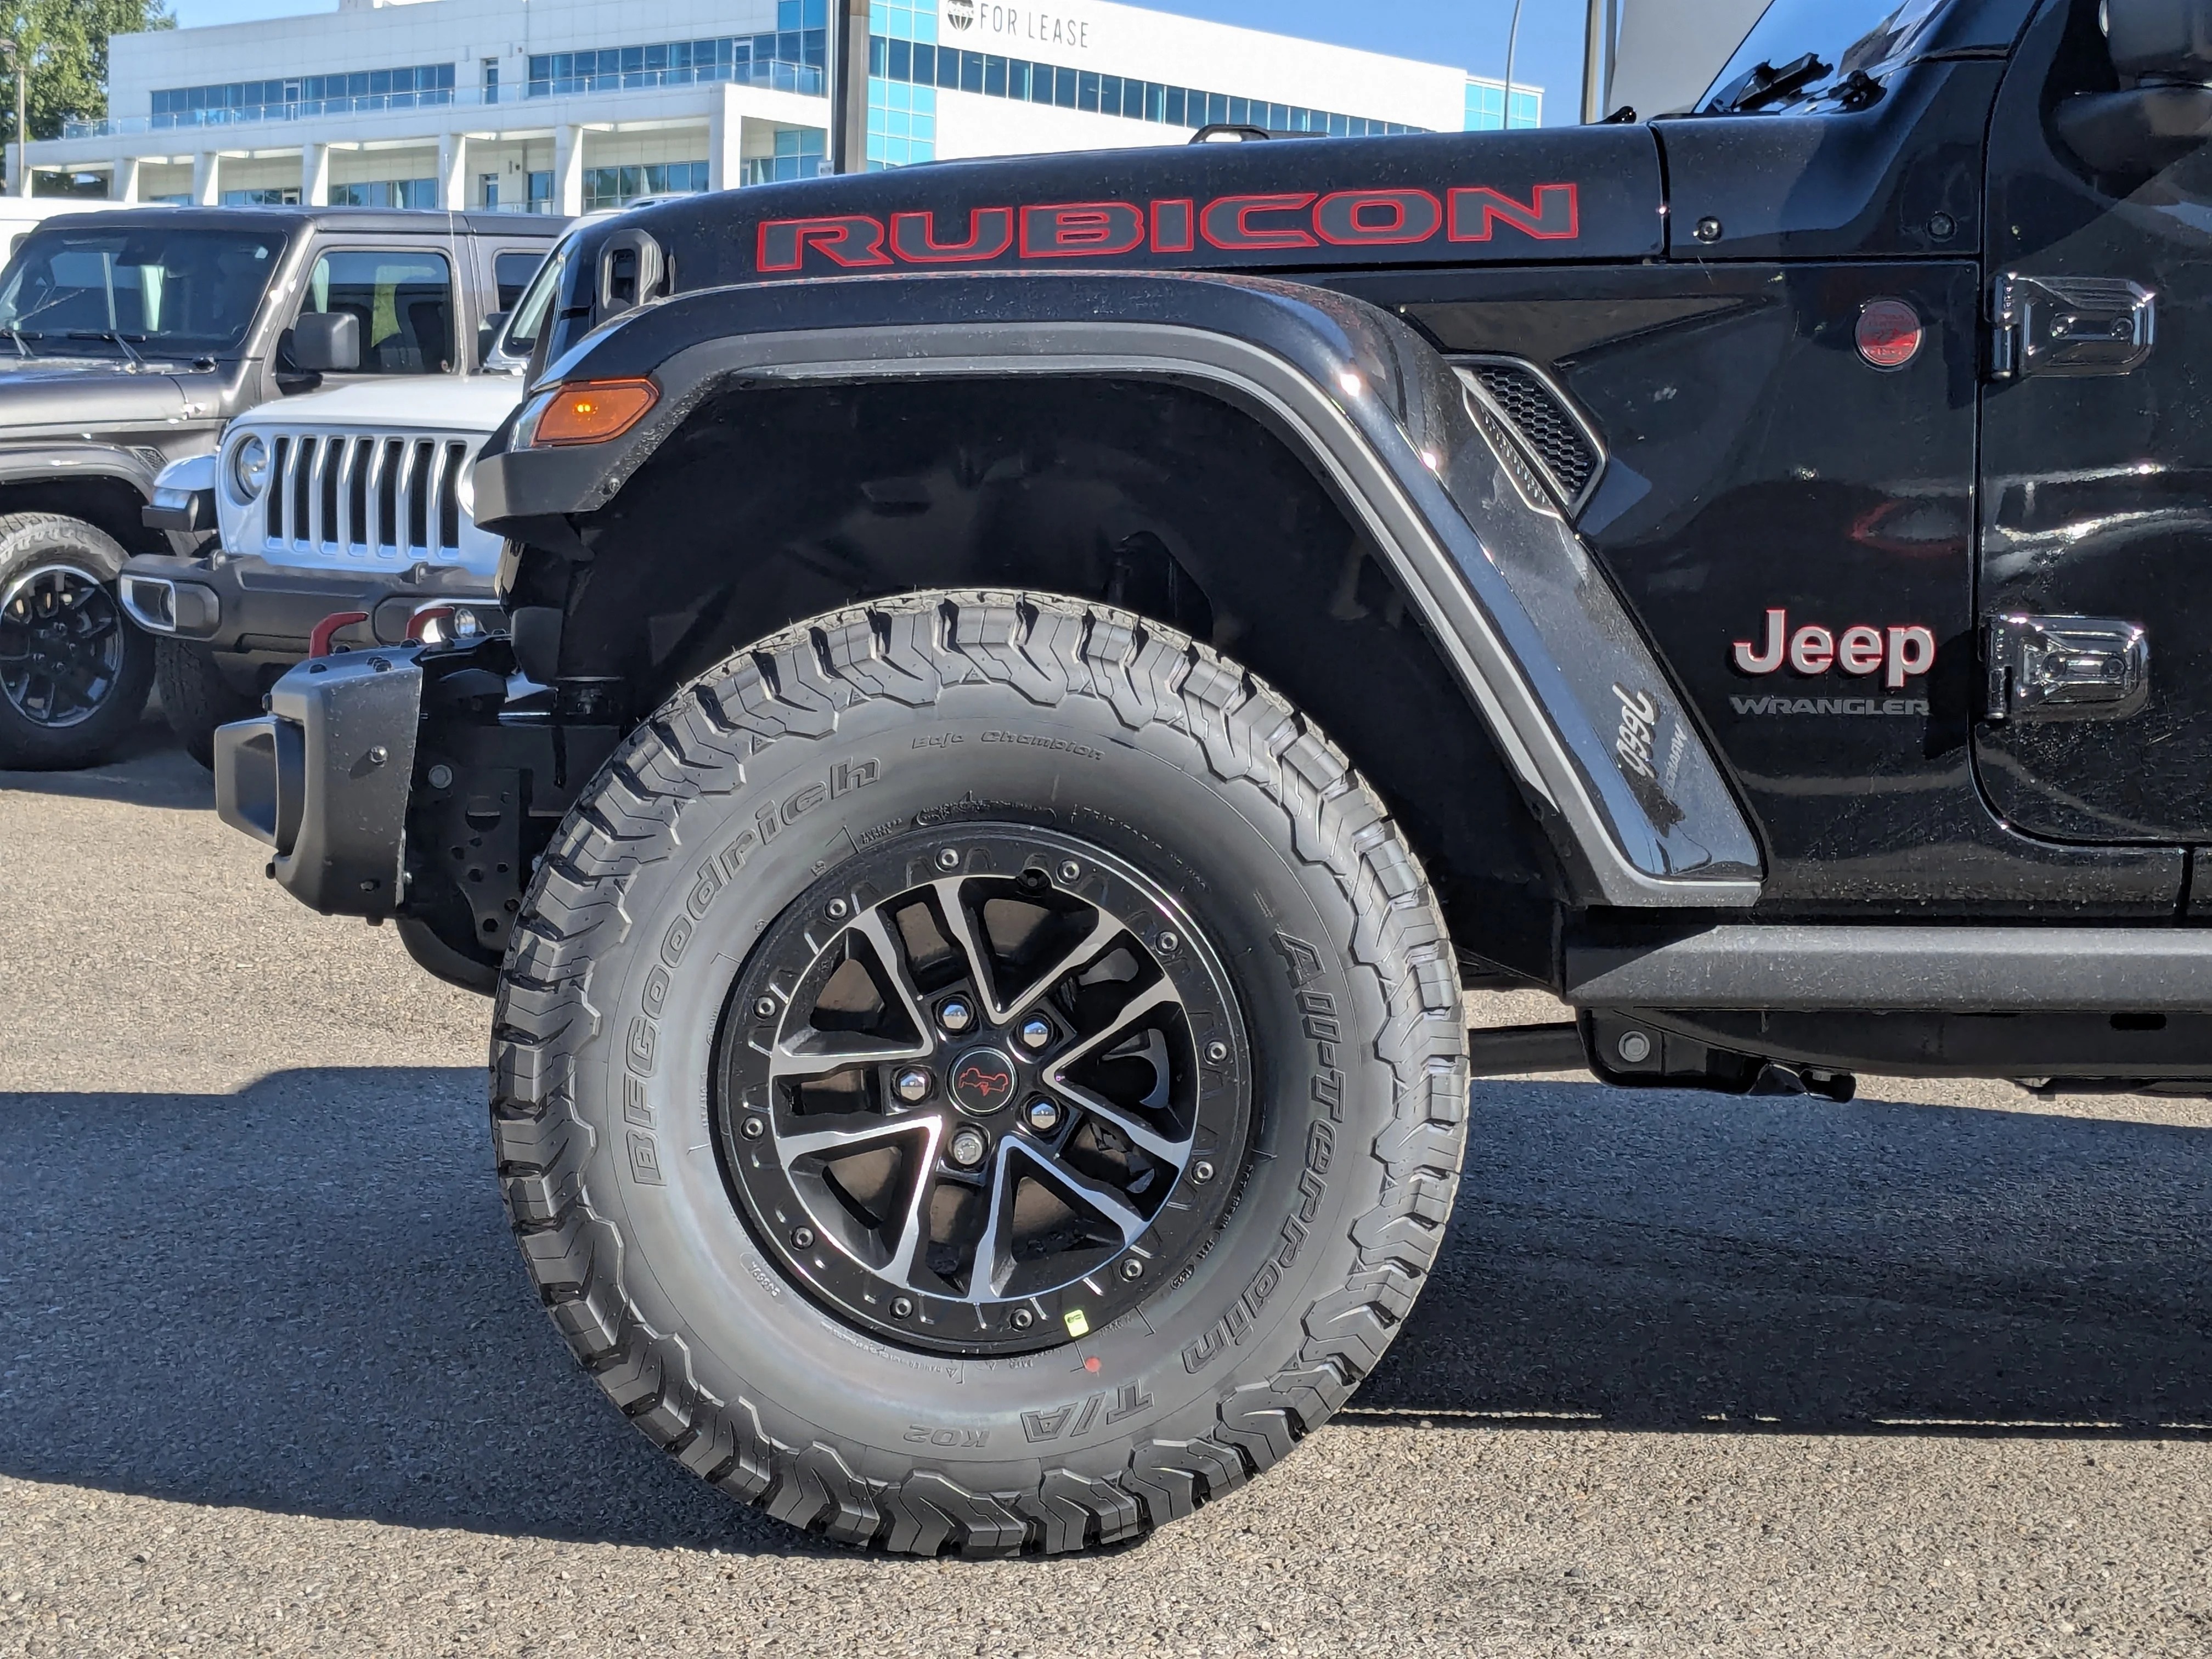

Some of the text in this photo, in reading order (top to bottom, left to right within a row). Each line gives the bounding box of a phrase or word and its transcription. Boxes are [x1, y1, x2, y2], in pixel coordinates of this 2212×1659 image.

[981, 3, 1089, 48] FOR LEASE
[756, 183, 1578, 272] RUBICON
[1732, 608, 1936, 689] Jeep
[1729, 696, 1930, 716] WRANGLER
[981, 730, 1105, 760] Champion
[623, 757, 882, 1186] BFGoodrich
[1182, 930, 1346, 1374] All-Terrain
[1020, 1378, 1154, 1443] T/A
